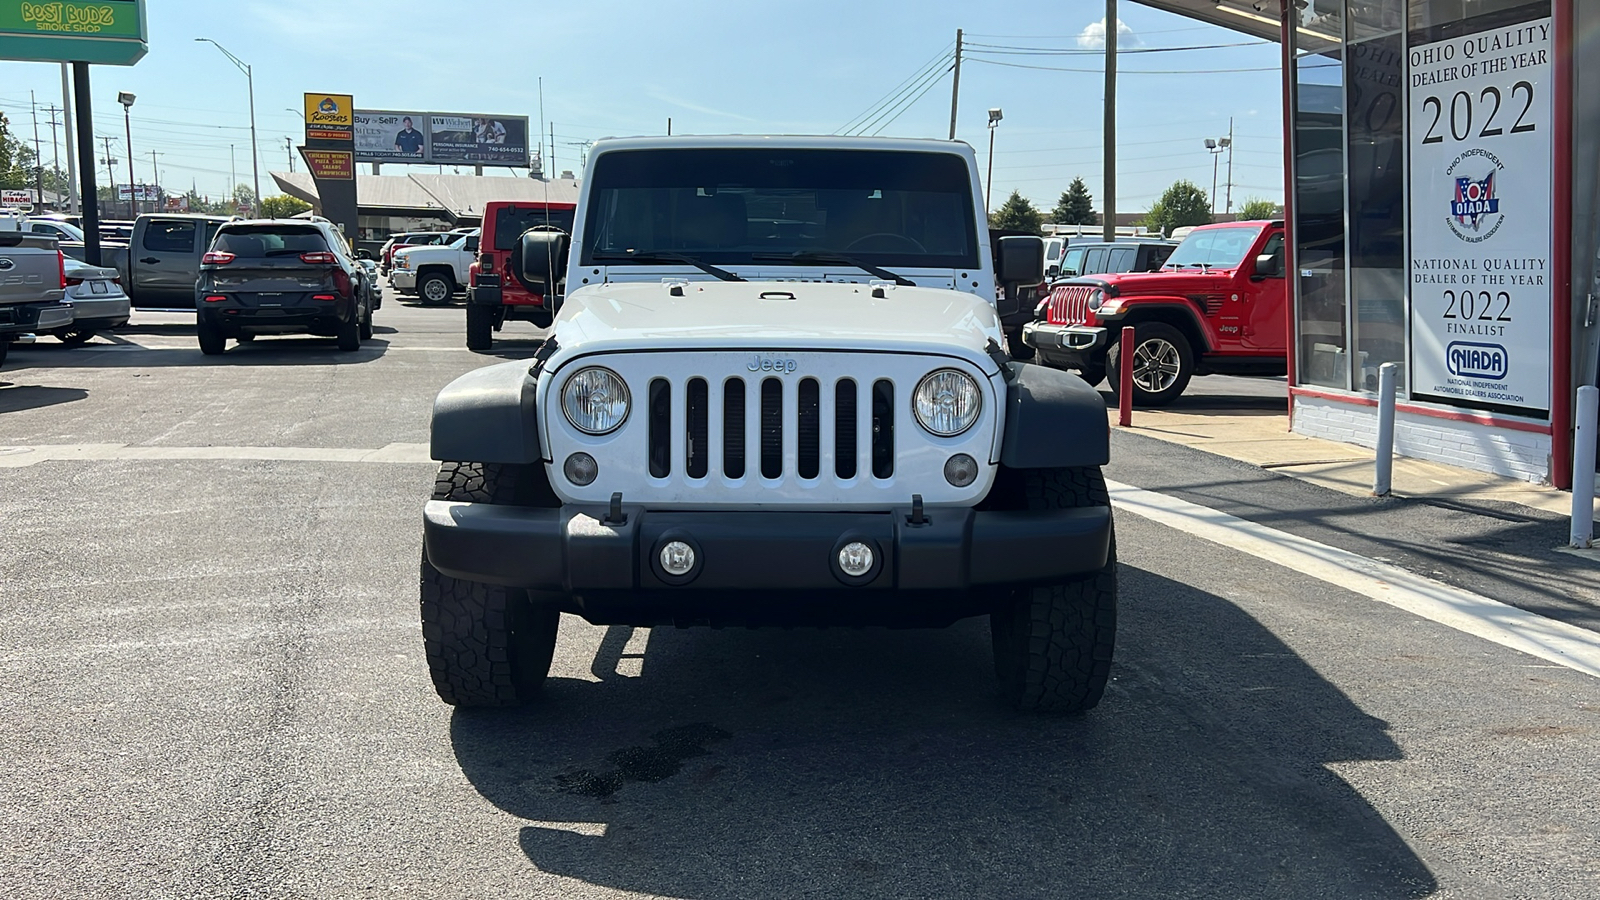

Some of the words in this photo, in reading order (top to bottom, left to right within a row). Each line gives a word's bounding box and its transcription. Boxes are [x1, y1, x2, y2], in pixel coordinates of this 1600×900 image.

[36, 22, 72, 32] SMOKE
[73, 24, 101, 33] SHOP
[1411, 44, 1455, 67] OHIO
[1463, 23, 1550, 58] QUALITY
[1412, 67, 1458, 88] DEALER
[1461, 62, 1478, 79] OF
[1481, 57, 1508, 75] THE
[1510, 49, 1547, 69] YEAR
[311, 111, 348, 123] Roosters
[1422, 80, 1536, 145] 2022
[354, 116, 370, 125] Buy
[379, 116, 398, 125] Sell?
[1446, 156, 1461, 176] OHIO
[1461, 148, 1505, 171] INDEPENDENT
[1456, 200, 1491, 214] OIADA
[1446, 217, 1465, 241] AUTOMOBILE
[1465, 235, 1483, 243] DEALERS
[1483, 213, 1505, 241] ASSOCIATION
[1413, 258, 1478, 270] NATIONAL
[1483, 258, 1546, 272] QUALITY
[1415, 273, 1457, 284] DEALER
[1462, 274, 1477, 285] OF
[1481, 274, 1505, 285] THE
[1511, 274, 1544, 286] YEAR
[1443, 289, 1512, 322] 2022
[1219, 324, 1239, 333] Jeep
[1447, 323, 1505, 337] FINALIST
[747, 355, 797, 375] Jeep
[1451, 348, 1502, 373] NIADA
[1447, 378, 1472, 387] NATIONAL
[1472, 381, 1508, 391] INDEPENDENT
[1433, 385, 1464, 395] AUTOMOBILE
[1465, 389, 1487, 398] DEALERS
[1487, 392, 1524, 402] ASSOCIATION
